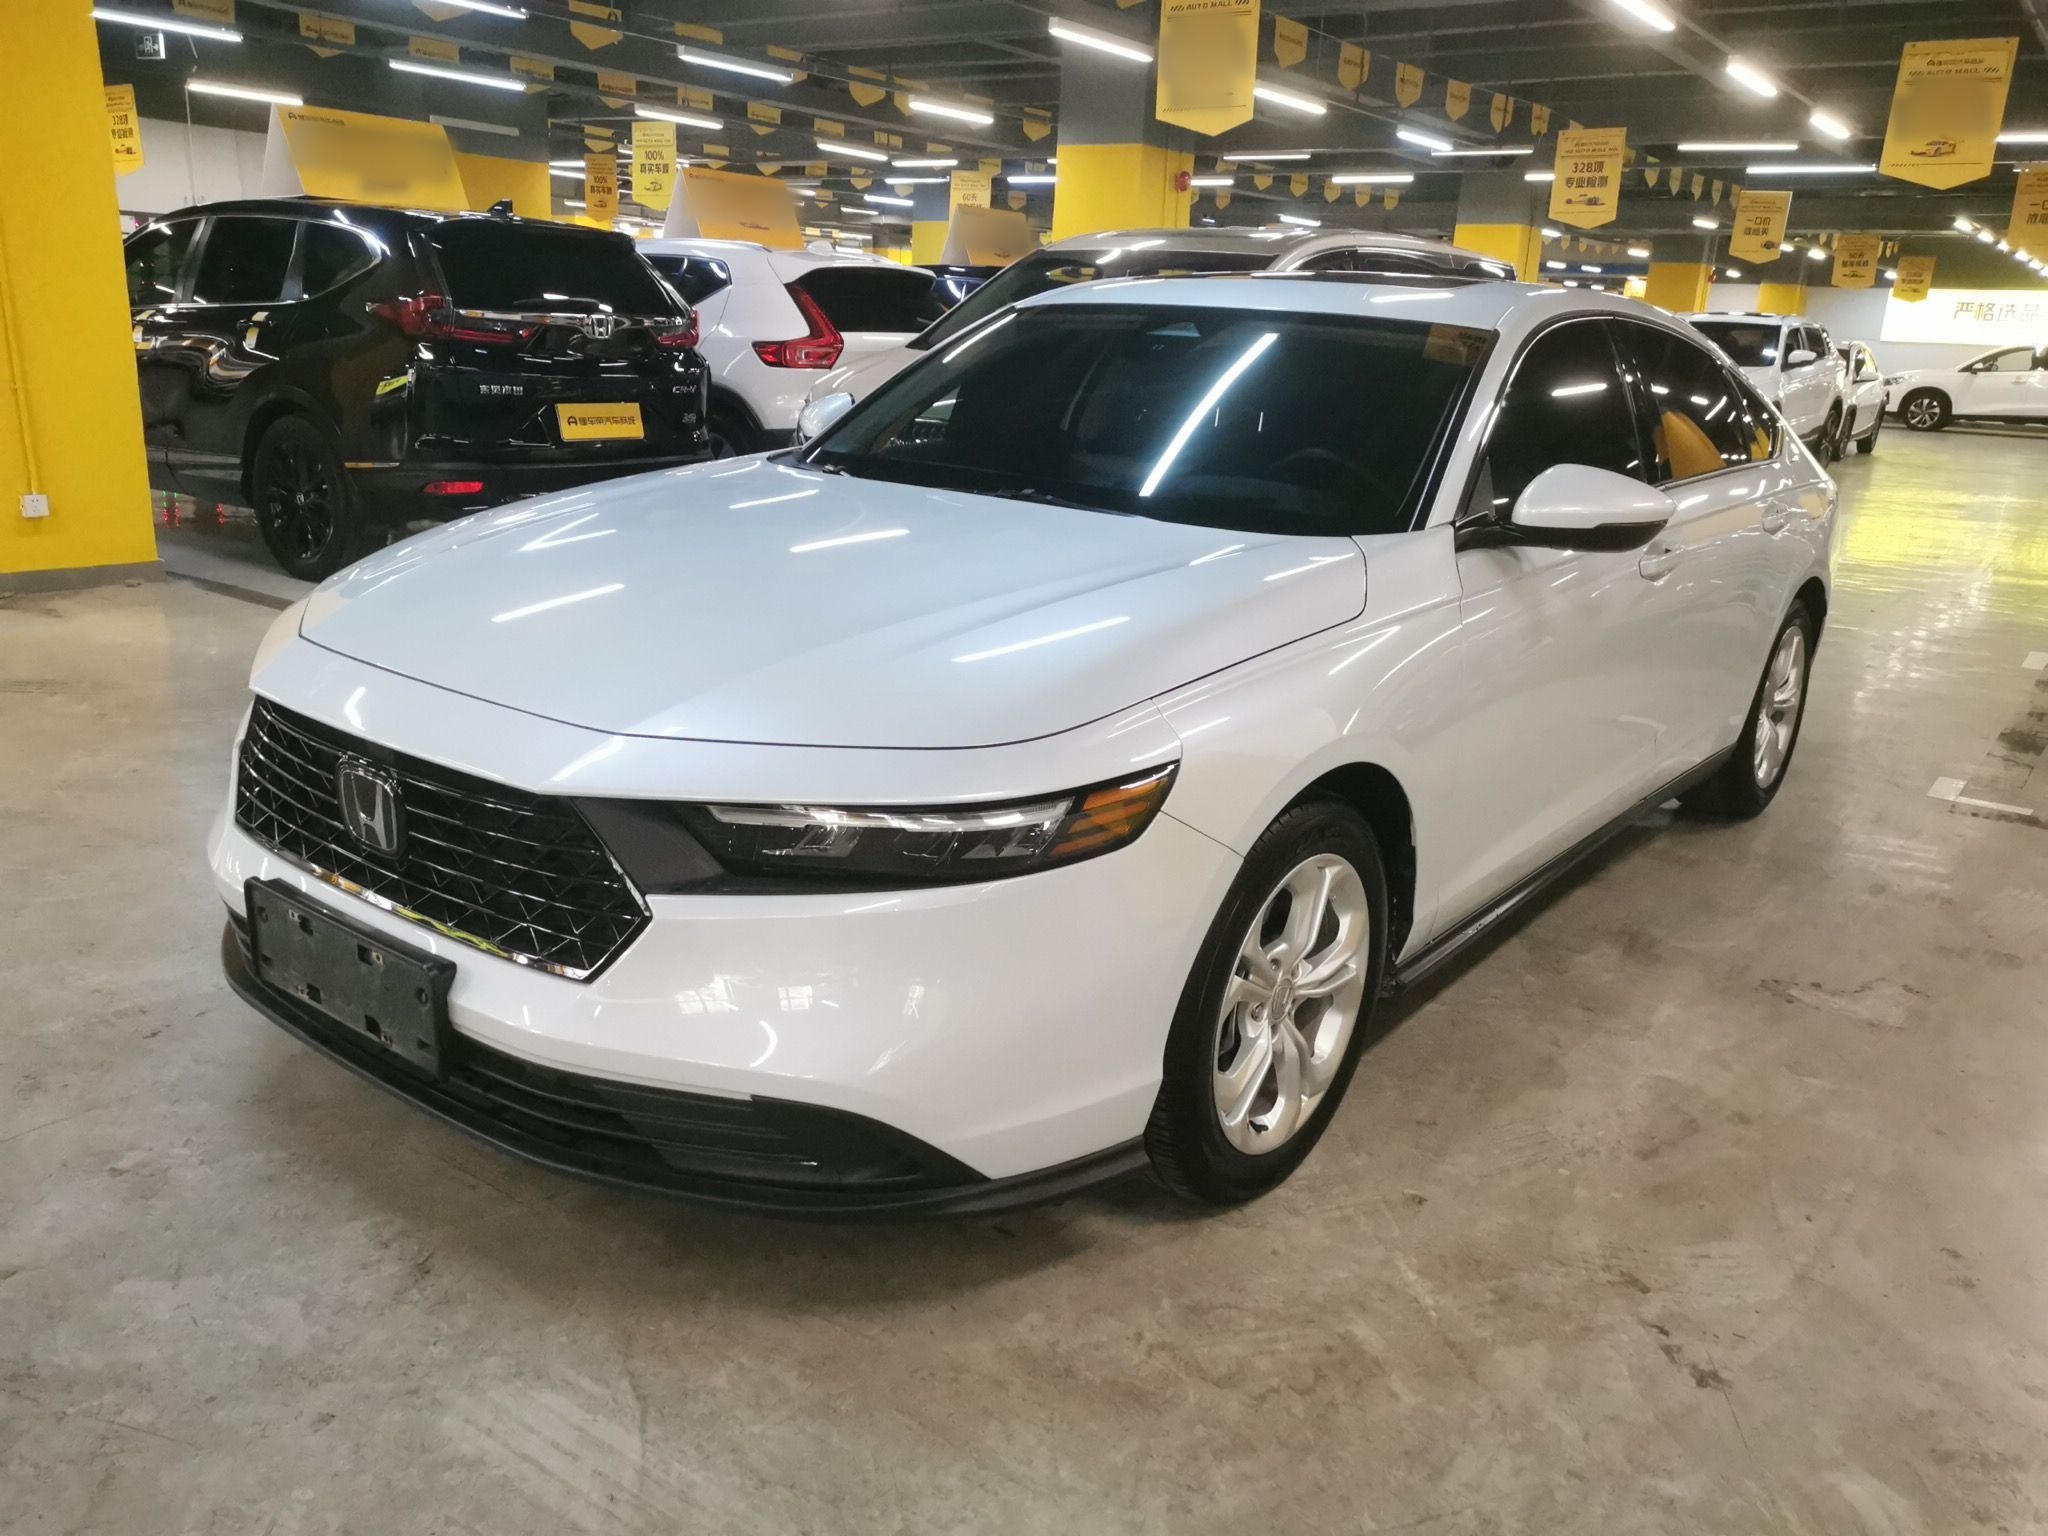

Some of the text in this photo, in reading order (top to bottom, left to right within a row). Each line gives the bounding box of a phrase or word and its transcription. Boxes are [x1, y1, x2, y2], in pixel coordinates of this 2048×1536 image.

[1186, 0, 1233, 11] AUTO MALL
[645, 150, 664, 161] 100%
[1572, 161, 1605, 173] 328项
[1566, 175, 1608, 188] 专业检测
[1953, 302, 2040, 322] 严格选品
